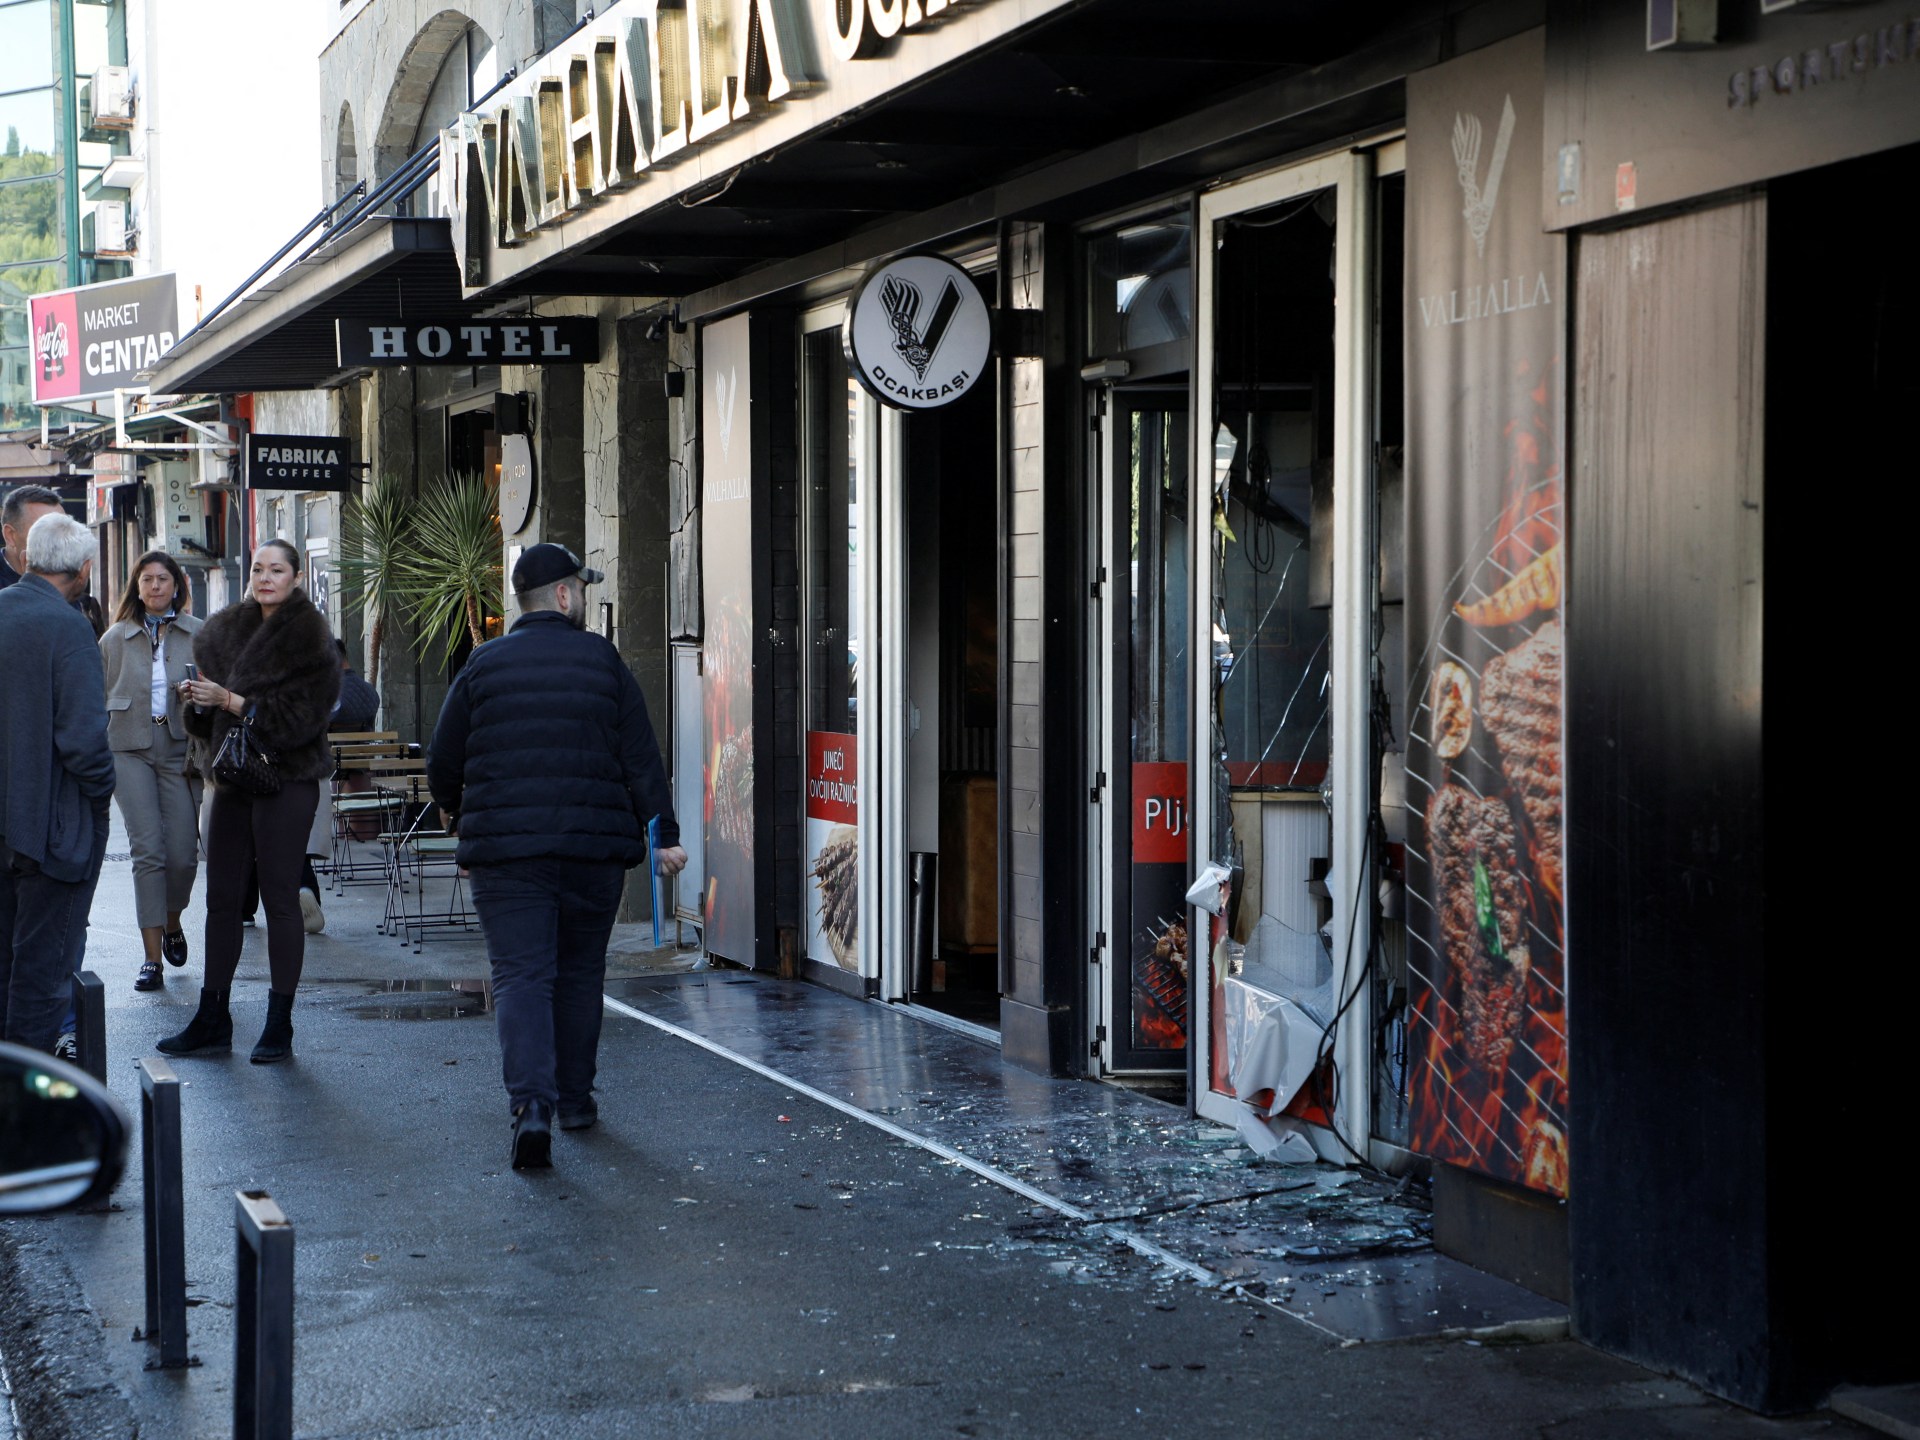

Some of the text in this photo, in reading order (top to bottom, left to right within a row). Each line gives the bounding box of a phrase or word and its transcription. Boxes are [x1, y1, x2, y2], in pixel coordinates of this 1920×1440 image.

[1419, 271, 1551, 328] VALHALLA
[84, 302, 140, 332] MARKET
[368, 326, 571, 358] HOTEL
[872, 365, 970, 400] OCAKBAŞI
[257, 447, 339, 465] FABRIKA
[266, 467, 331, 479] COFFEE
[706, 476, 749, 502] VALHALLA
[823, 747, 844, 773] JUNEĆI
[1145, 798, 1189, 836] Plj
